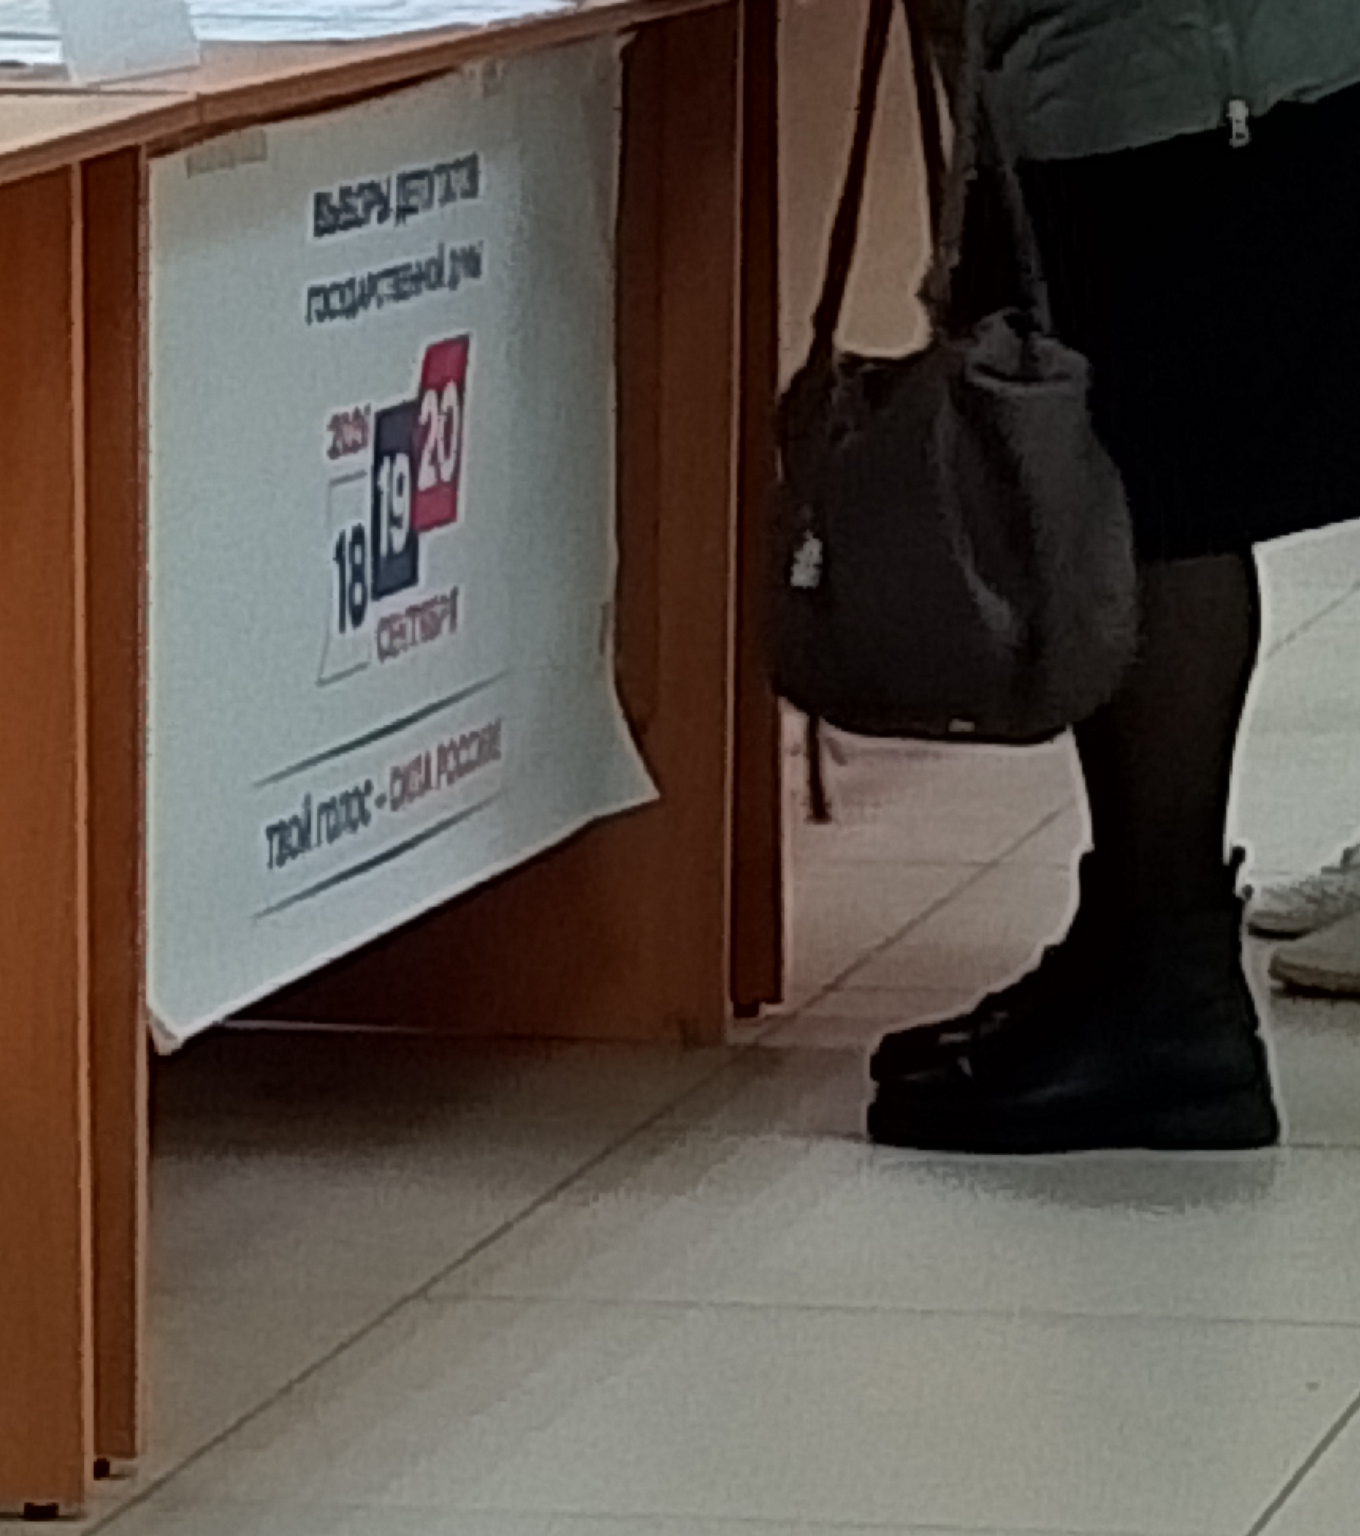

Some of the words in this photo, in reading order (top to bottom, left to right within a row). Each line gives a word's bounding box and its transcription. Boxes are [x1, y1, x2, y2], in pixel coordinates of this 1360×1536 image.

[333, 522, 369, 634] 18
[377, 451, 411, 559] 19
[417, 379, 459, 492] 20
